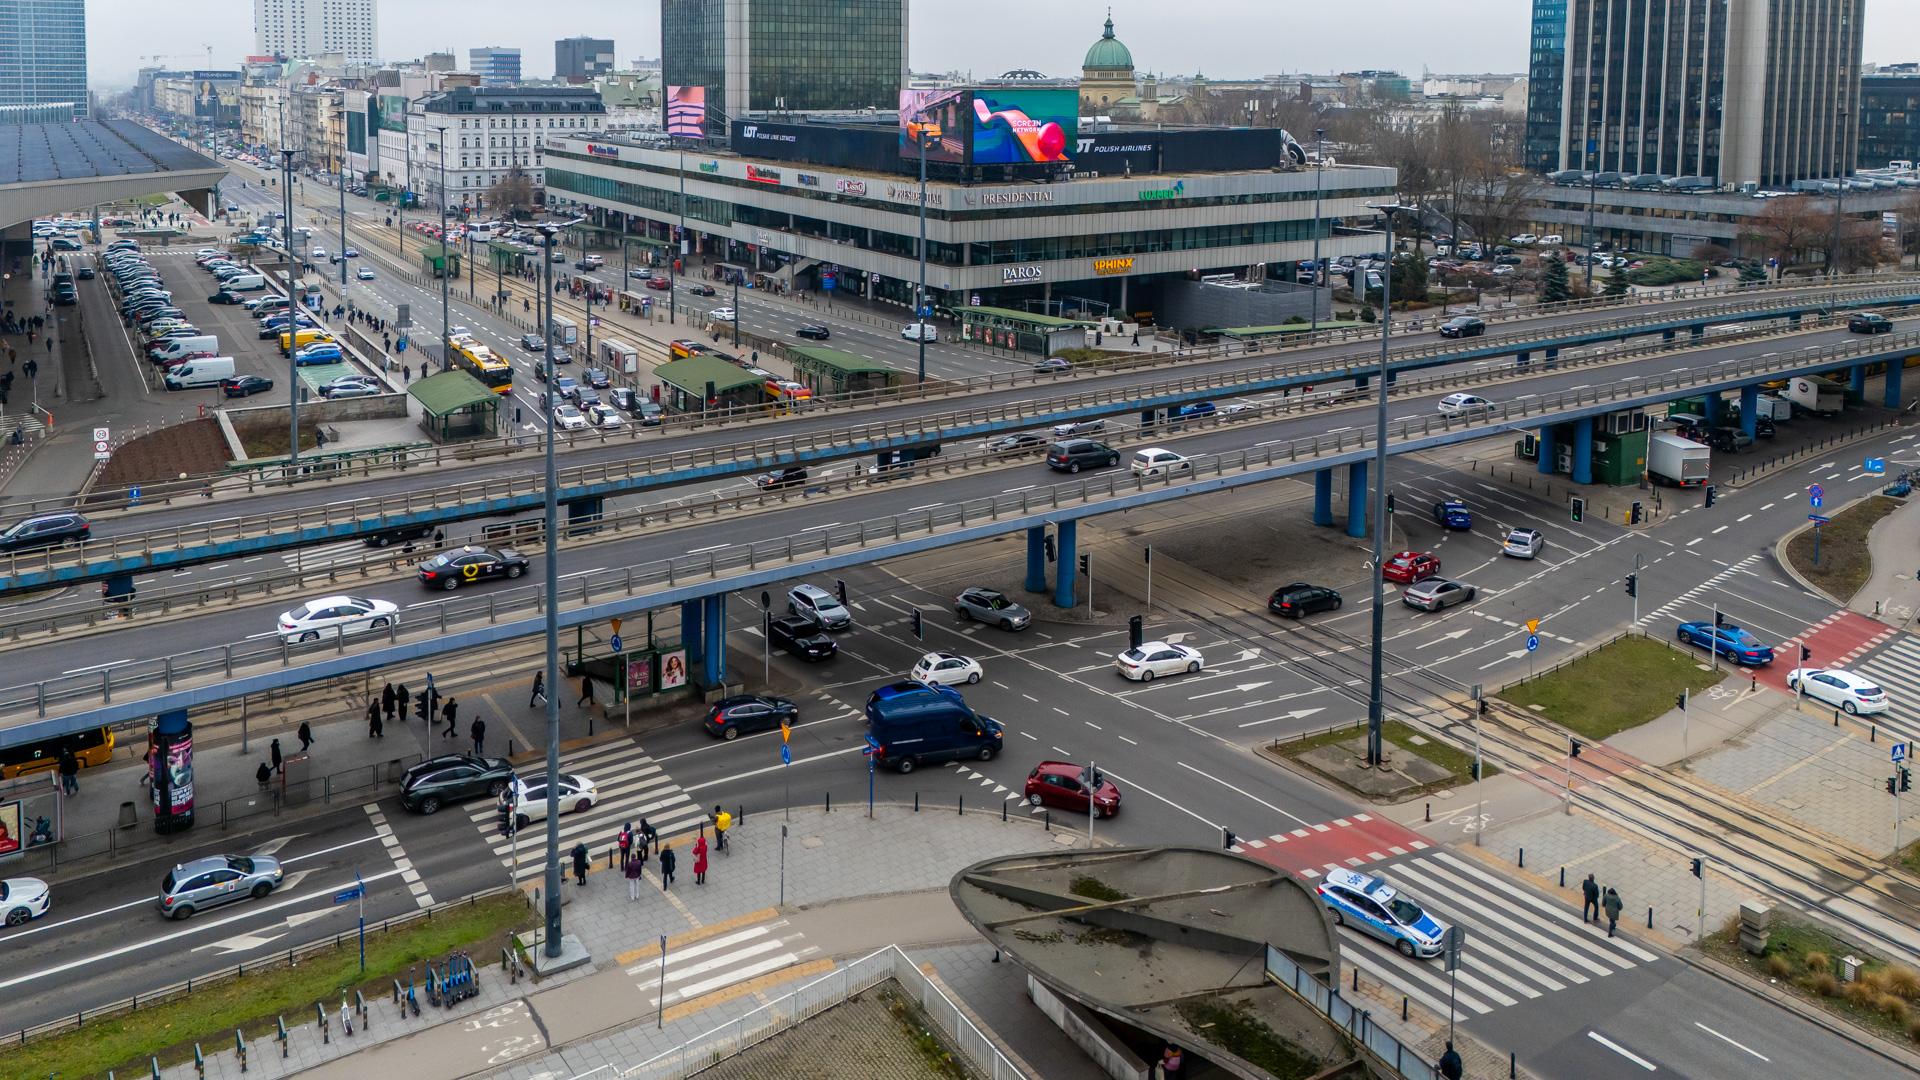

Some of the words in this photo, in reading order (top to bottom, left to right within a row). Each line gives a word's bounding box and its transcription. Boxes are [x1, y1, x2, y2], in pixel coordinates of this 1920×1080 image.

[743, 125, 758, 139] LOT
[1094, 145, 1120, 153] POLISH
[1120, 144, 1152, 152] AIRLINES
[983, 191, 1055, 204] PRESIDENTIAL
[1094, 257, 1135, 271] SPHINX
[1003, 265, 1042, 280] PAROS
